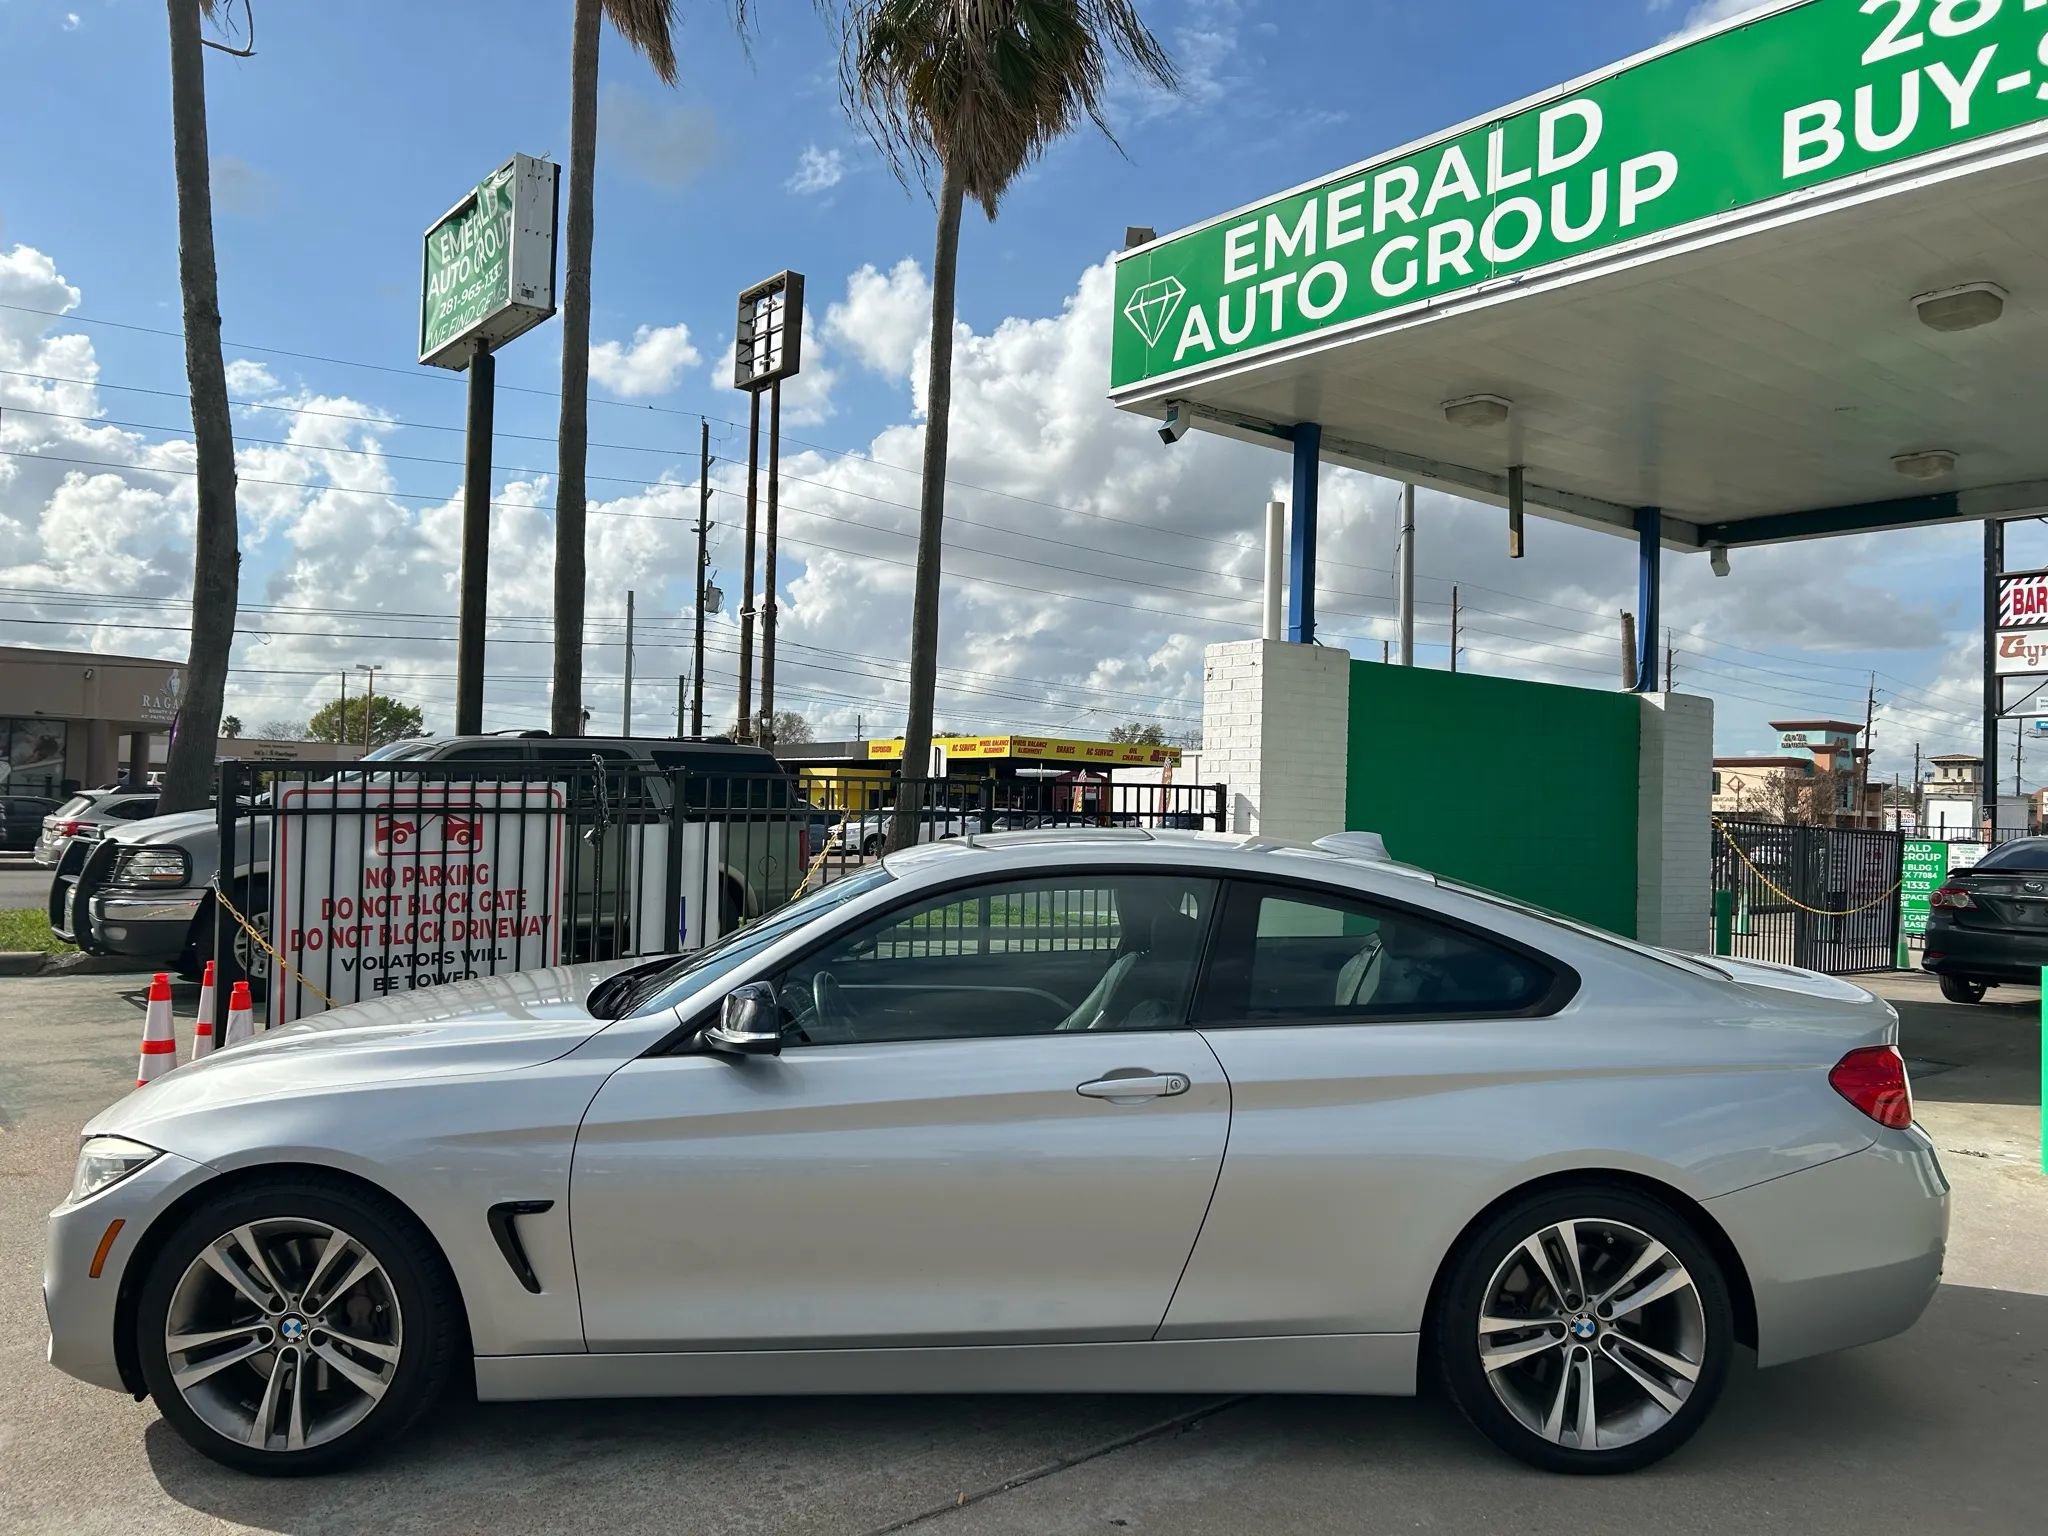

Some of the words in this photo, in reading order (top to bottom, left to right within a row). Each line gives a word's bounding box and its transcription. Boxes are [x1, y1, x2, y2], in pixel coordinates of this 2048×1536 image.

[1859, 0, 2048, 66] 28
[1783, 31, 2048, 180] BUY-
[1223, 98, 1604, 285] EMERALD
[441, 185, 498, 264] EMERLD
[1172, 260, 1348, 362] AUTO
[1370, 150, 1679, 297] GROUP
[428, 256, 470, 301] AUTO
[440, 258, 503, 319] 281-965-1333
[430, 322, 448, 349] WE
[448, 305, 475, 335] FIND
[142, 694, 183, 710] RAGA
[1056, 745, 1076, 754] BRAKES
[1094, 748, 1114, 757] SERVICE
[1122, 754, 1144, 762] CHANGE
[365, 866, 396, 889] NO
[402, 863, 489, 888] PARKING
[1907, 863, 1932, 871] BLDG
[1913, 871, 1938, 879] 77084
[321, 896, 354, 921] DO
[361, 894, 402, 919] NOT
[408, 891, 475, 916] BLOCK
[478, 889, 527, 913] GATE
[290, 927, 323, 952] DO
[329, 924, 373, 949] NOT
[379, 920, 445, 947] BLOCK
[451, 914, 552, 942] DRIVEWAY
[340, 950, 456, 972] VOLATORS
[461, 947, 508, 963] WILL
[373, 976, 400, 991] BE
